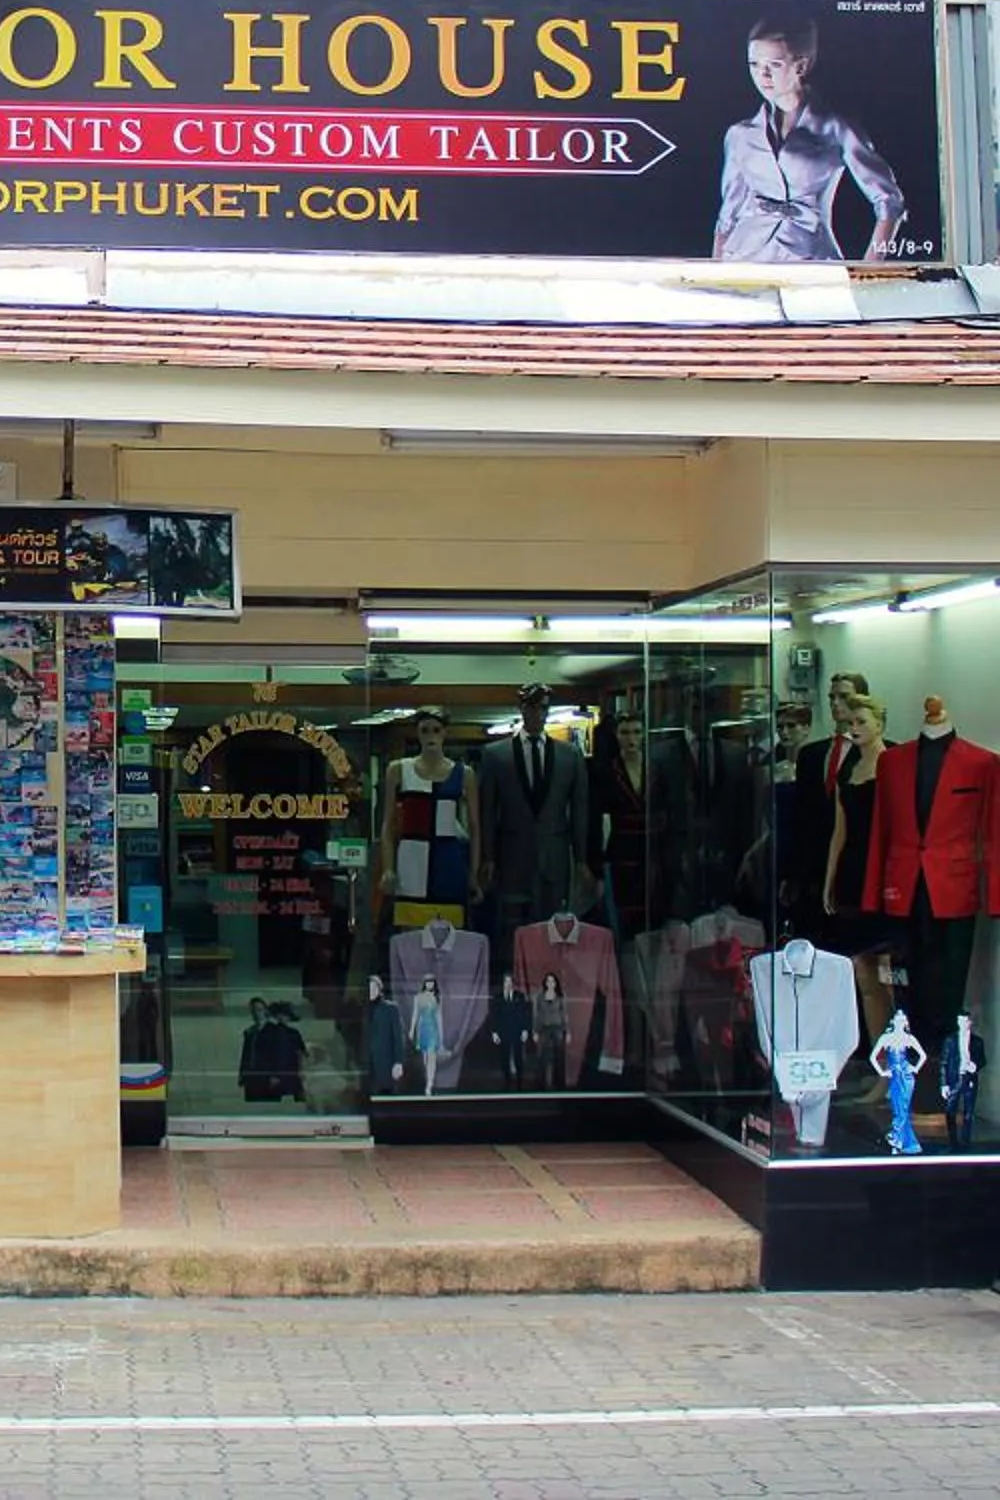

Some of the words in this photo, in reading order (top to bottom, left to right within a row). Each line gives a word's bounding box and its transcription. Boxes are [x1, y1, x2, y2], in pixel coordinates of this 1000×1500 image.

[224, 12, 687, 102] HOUSE
[173, 119, 400, 160] CUSTOM
[429, 125, 633, 167] TAILOR
[872, 239, 934, 257] 143/8-9
[12, 550, 60, 565] TOUR
[182, 724, 227, 775] STAR
[225, 710, 297, 735] TAILOR
[125, 770, 150, 781] VISA
[178, 792, 350, 819] WELCOME
